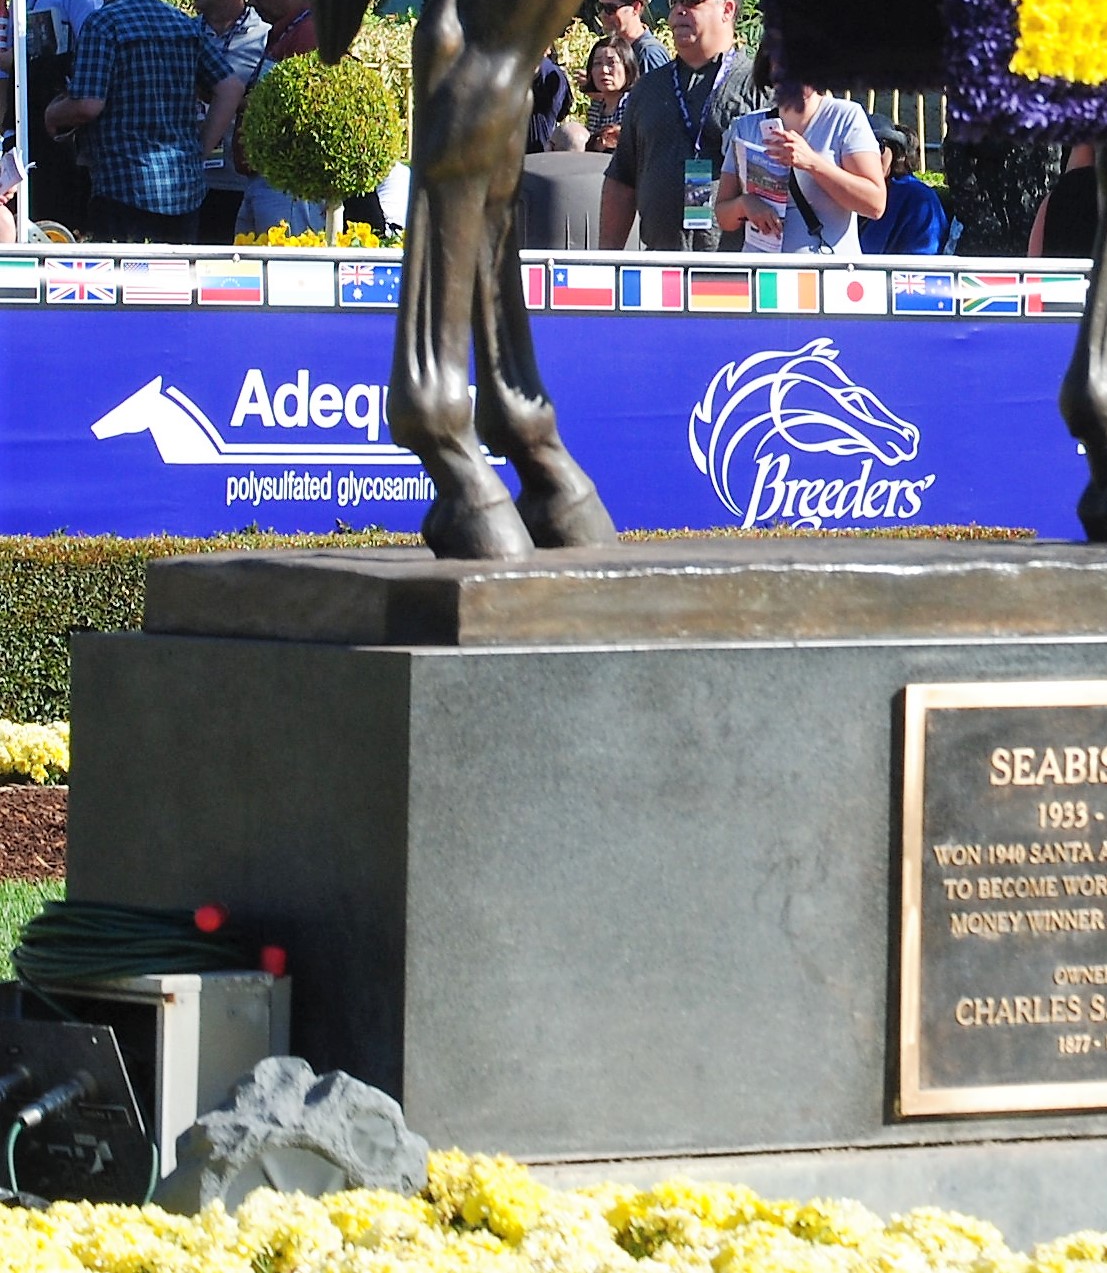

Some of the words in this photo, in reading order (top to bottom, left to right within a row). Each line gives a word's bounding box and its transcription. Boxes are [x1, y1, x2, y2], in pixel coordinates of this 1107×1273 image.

[226, 470, 332, 507] polysulfated
[337, 470, 438, 508] glycosamin
[1037, 800, 1089, 829] 1933
[933, 843, 982, 866] WON
[988, 842, 1027, 865] 1940
[1029, 840, 1095, 865] SANTA
[943, 877, 974, 901] TO
[977, 875, 1059, 900] BECOME
[950, 909, 1023, 937] MONEY
[1026, 907, 1106, 934] WINNER
[955, 994, 1082, 1026] CHARLES
[1058, 1033, 1092, 1055] 1877
